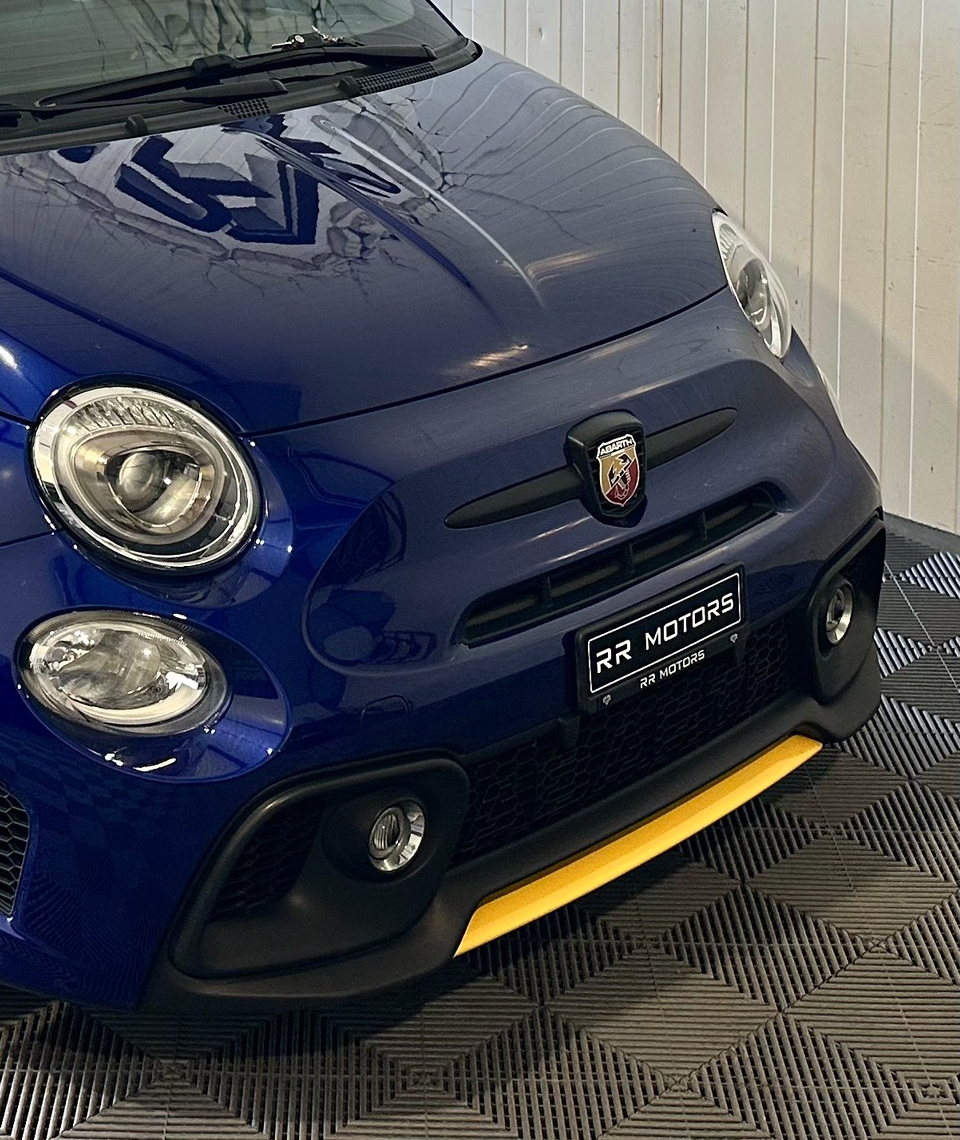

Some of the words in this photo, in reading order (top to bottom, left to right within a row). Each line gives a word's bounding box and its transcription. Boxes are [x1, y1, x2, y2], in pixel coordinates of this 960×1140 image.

[600, 438, 634, 456] ABARTH
[596, 639, 632, 674] RR
[644, 592, 734, 651] MOTORS
[640, 673, 656, 689] RR
[659, 649, 705, 680] MOTORS
